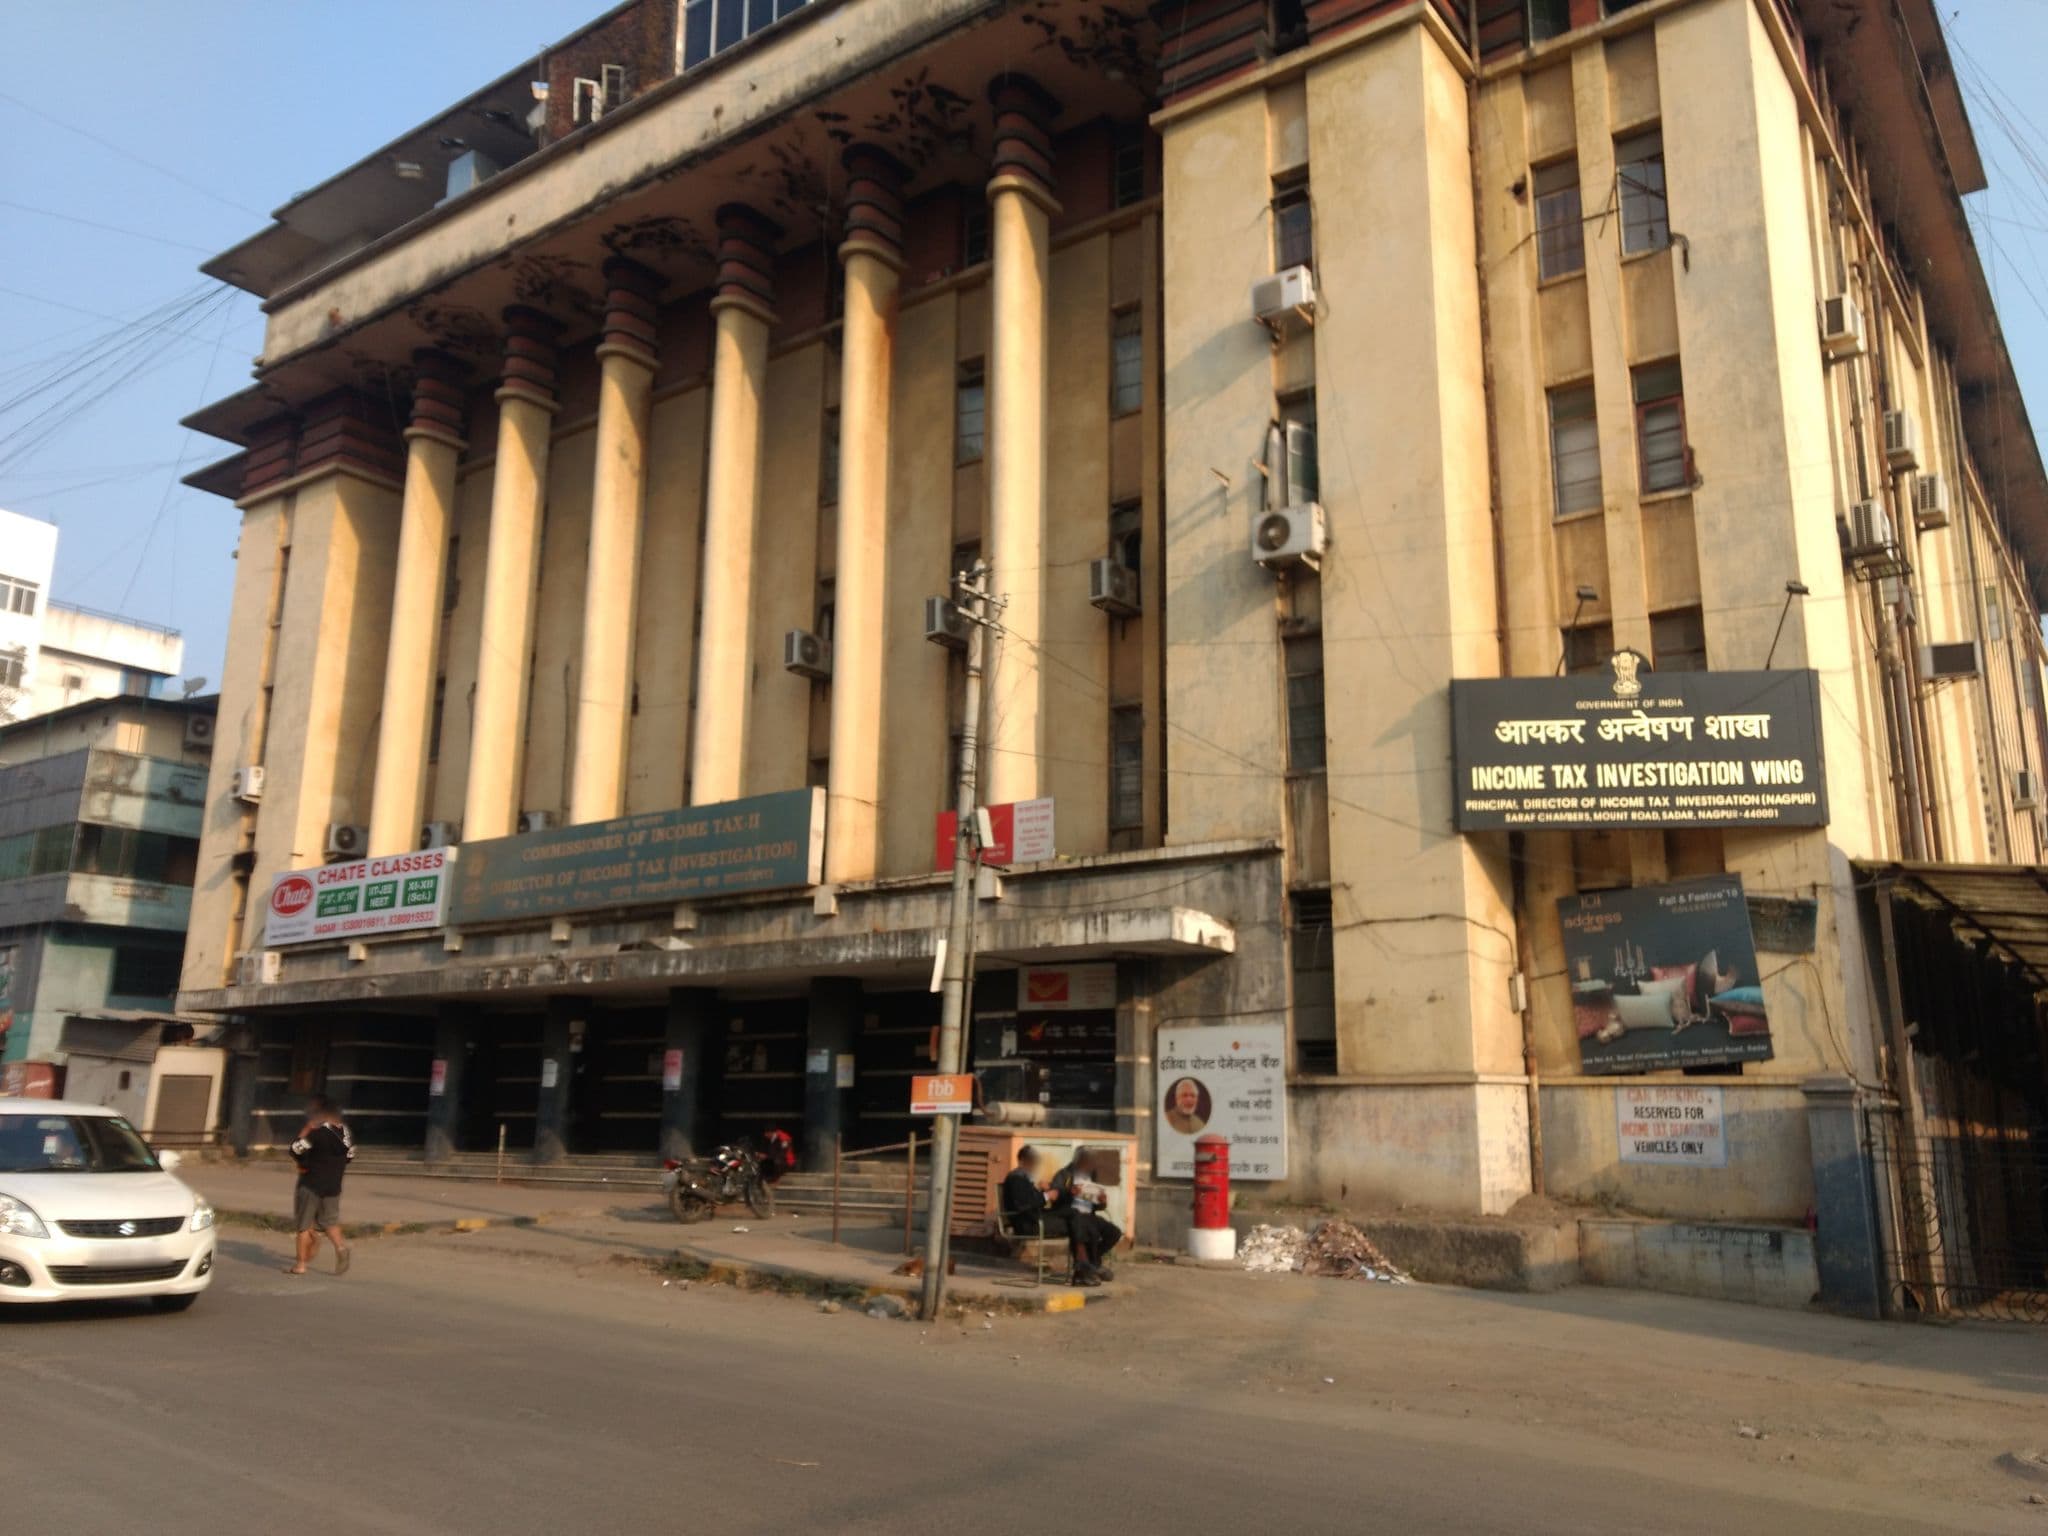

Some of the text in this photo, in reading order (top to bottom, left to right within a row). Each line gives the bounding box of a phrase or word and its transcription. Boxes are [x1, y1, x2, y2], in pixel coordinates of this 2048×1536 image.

[1575, 698, 1684, 710] GOVERNMENT OF INDIA
[1494, 709, 1771, 744] आयकर अन्वेषण शाखा
[1472, 759, 1804, 791] INCOME TAX INVESTIGATION WING
[1465, 791, 1817, 811] PRINCIPAL DIRECTOR OF INCOME TAX INVESTIGATION (NAGPUR)
[1505, 813, 1536, 823] SARAF
[1593, 811, 1629, 821] MOUNT
[522, 834, 625, 862] COMMISSIONER
[627, 831, 647, 846] OF
[651, 820, 708, 843] INCOME
[318, 853, 443, 885] CHATE CLASSES
[490, 874, 555, 896] DIRECTOR
[558, 869, 577, 887] OF
[579, 863, 633, 884] INCOME
[638, 858, 665, 875] TAX
[275, 884, 310, 908] Chate
[370, 896, 390, 908] NEET
[1564, 911, 1622, 929] address
[927, 1078, 954, 1097] fbb
[1633, 1106, 1704, 1120] RESERVED FOR
[1634, 1140, 1704, 1154] VEHICLES ONLY
